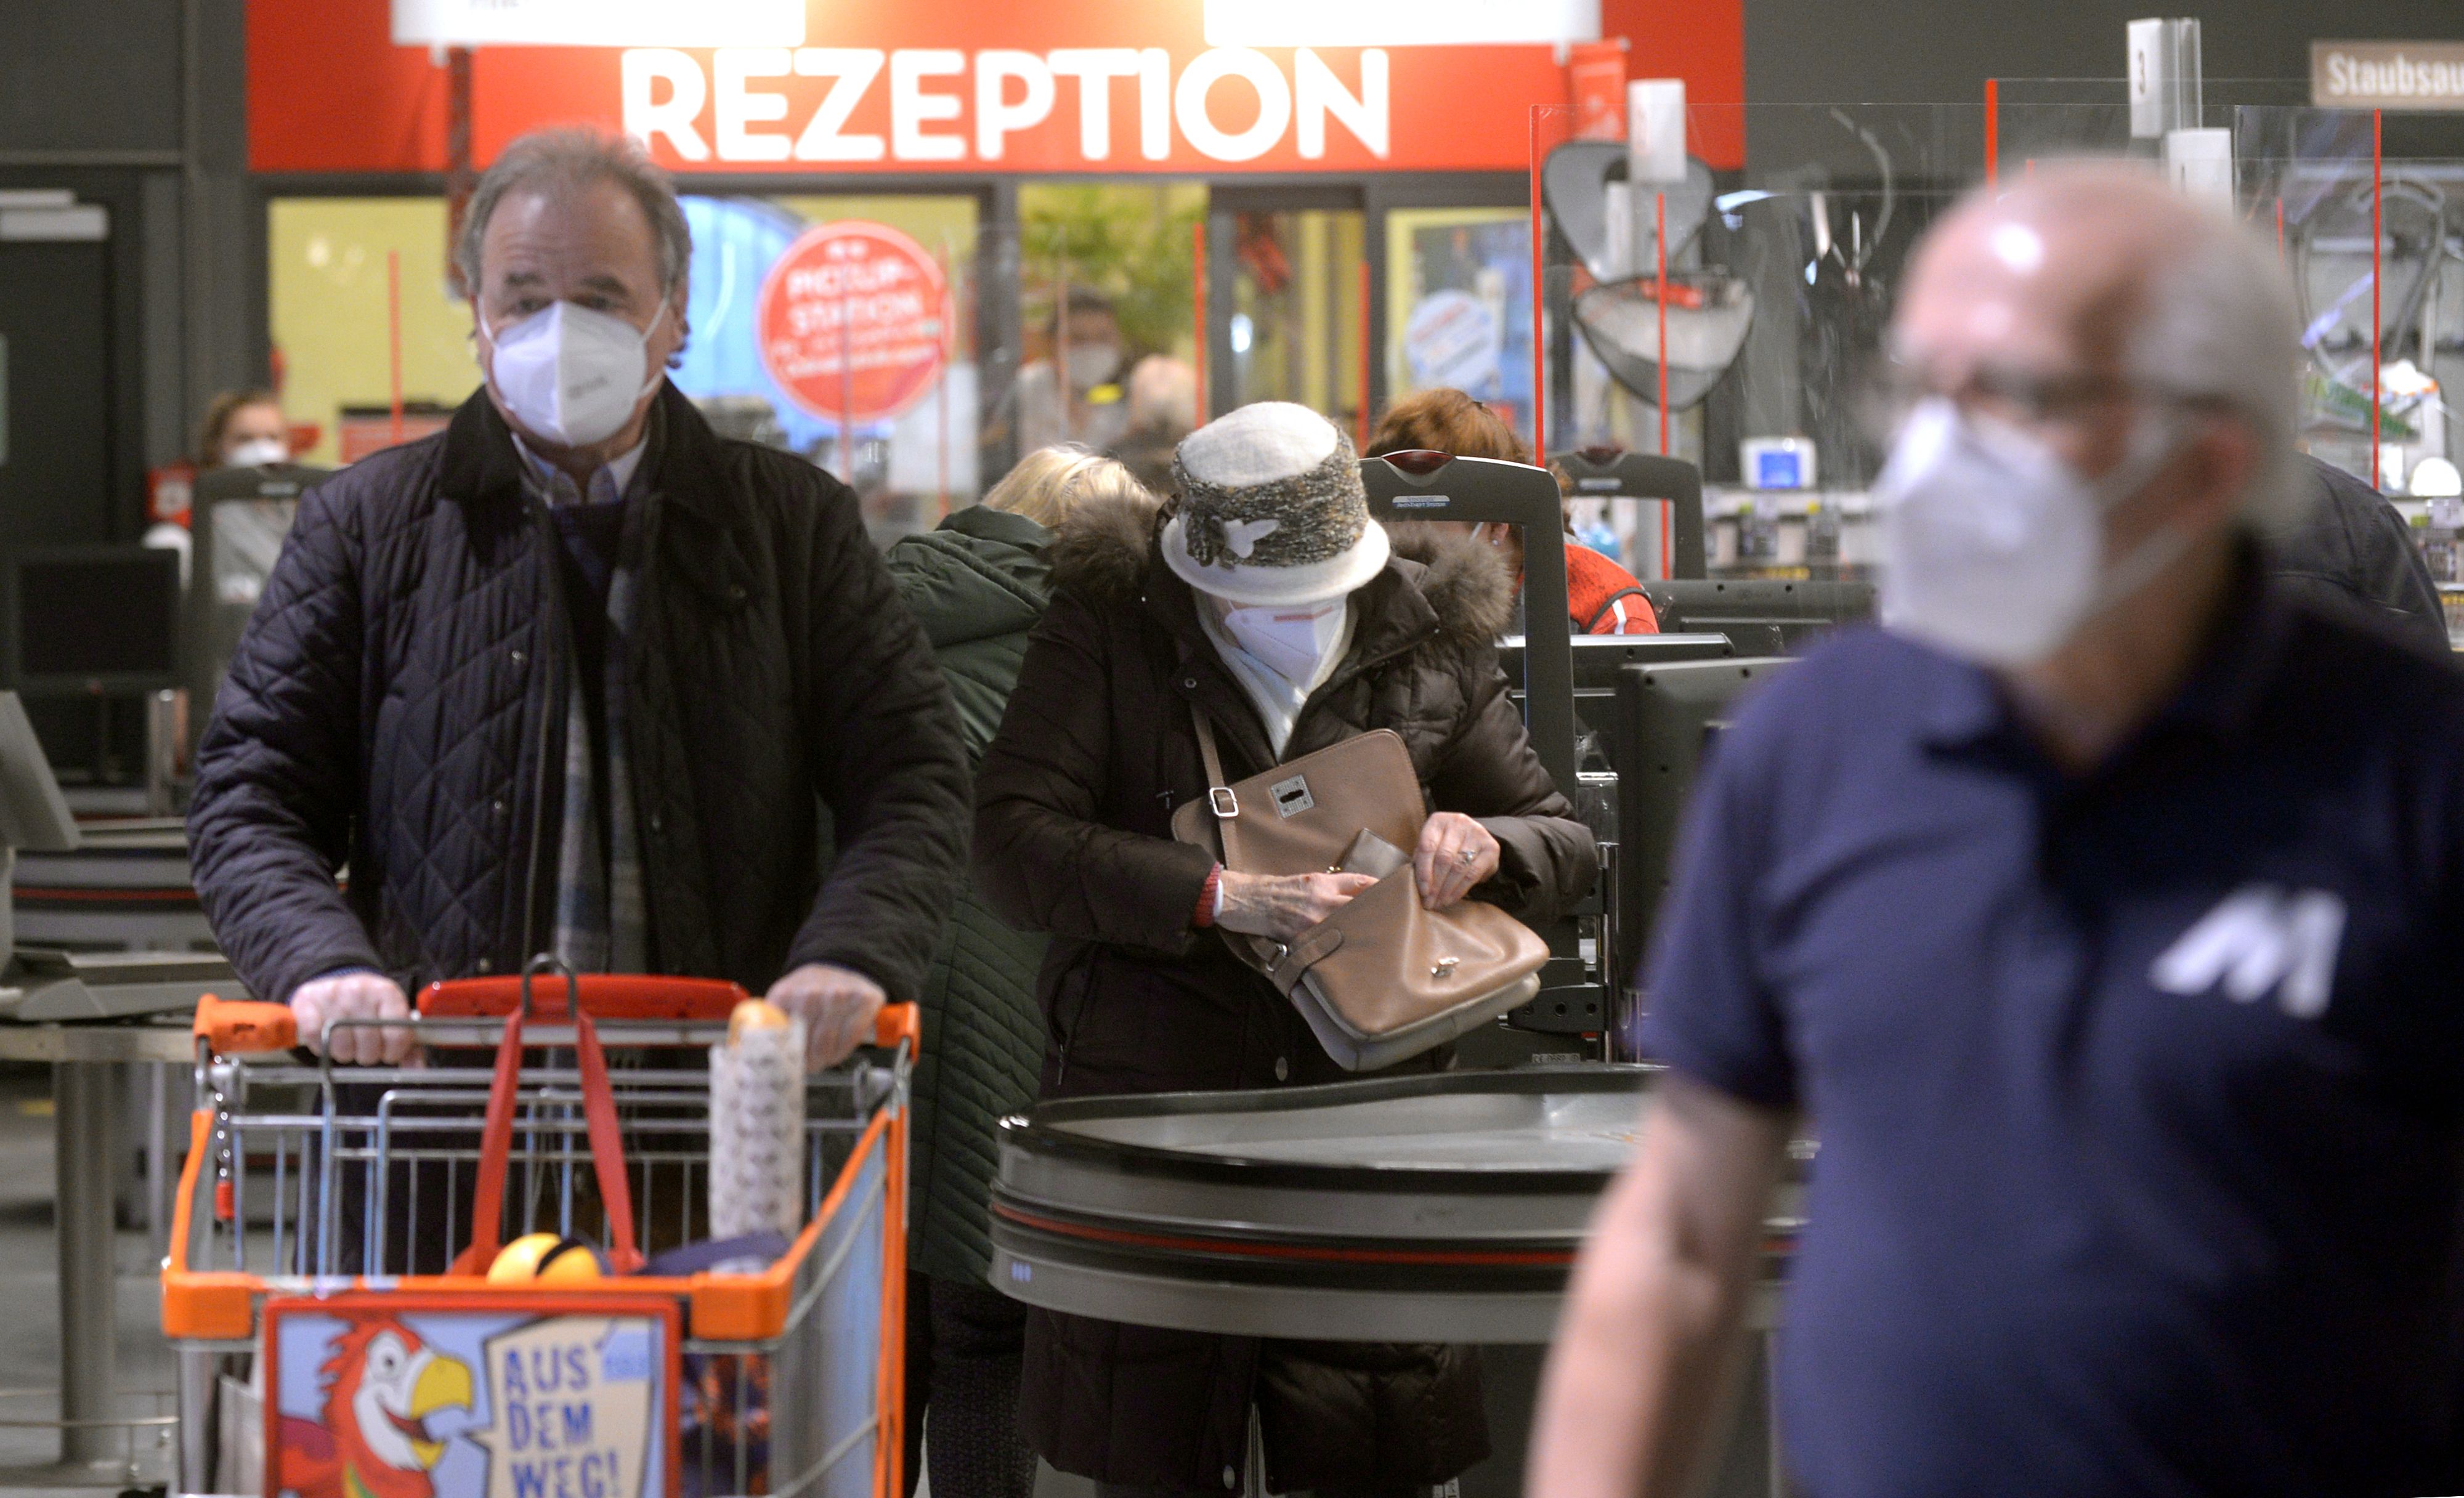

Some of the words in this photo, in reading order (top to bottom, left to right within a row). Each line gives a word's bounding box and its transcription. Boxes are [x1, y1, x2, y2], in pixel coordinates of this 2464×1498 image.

[622, 47, 1390, 162] REZEPTION
[505, 1346, 588, 1398] AUS
[508, 1399, 593, 1451] DEM
[511, 1451, 619, 1498] WEG!
